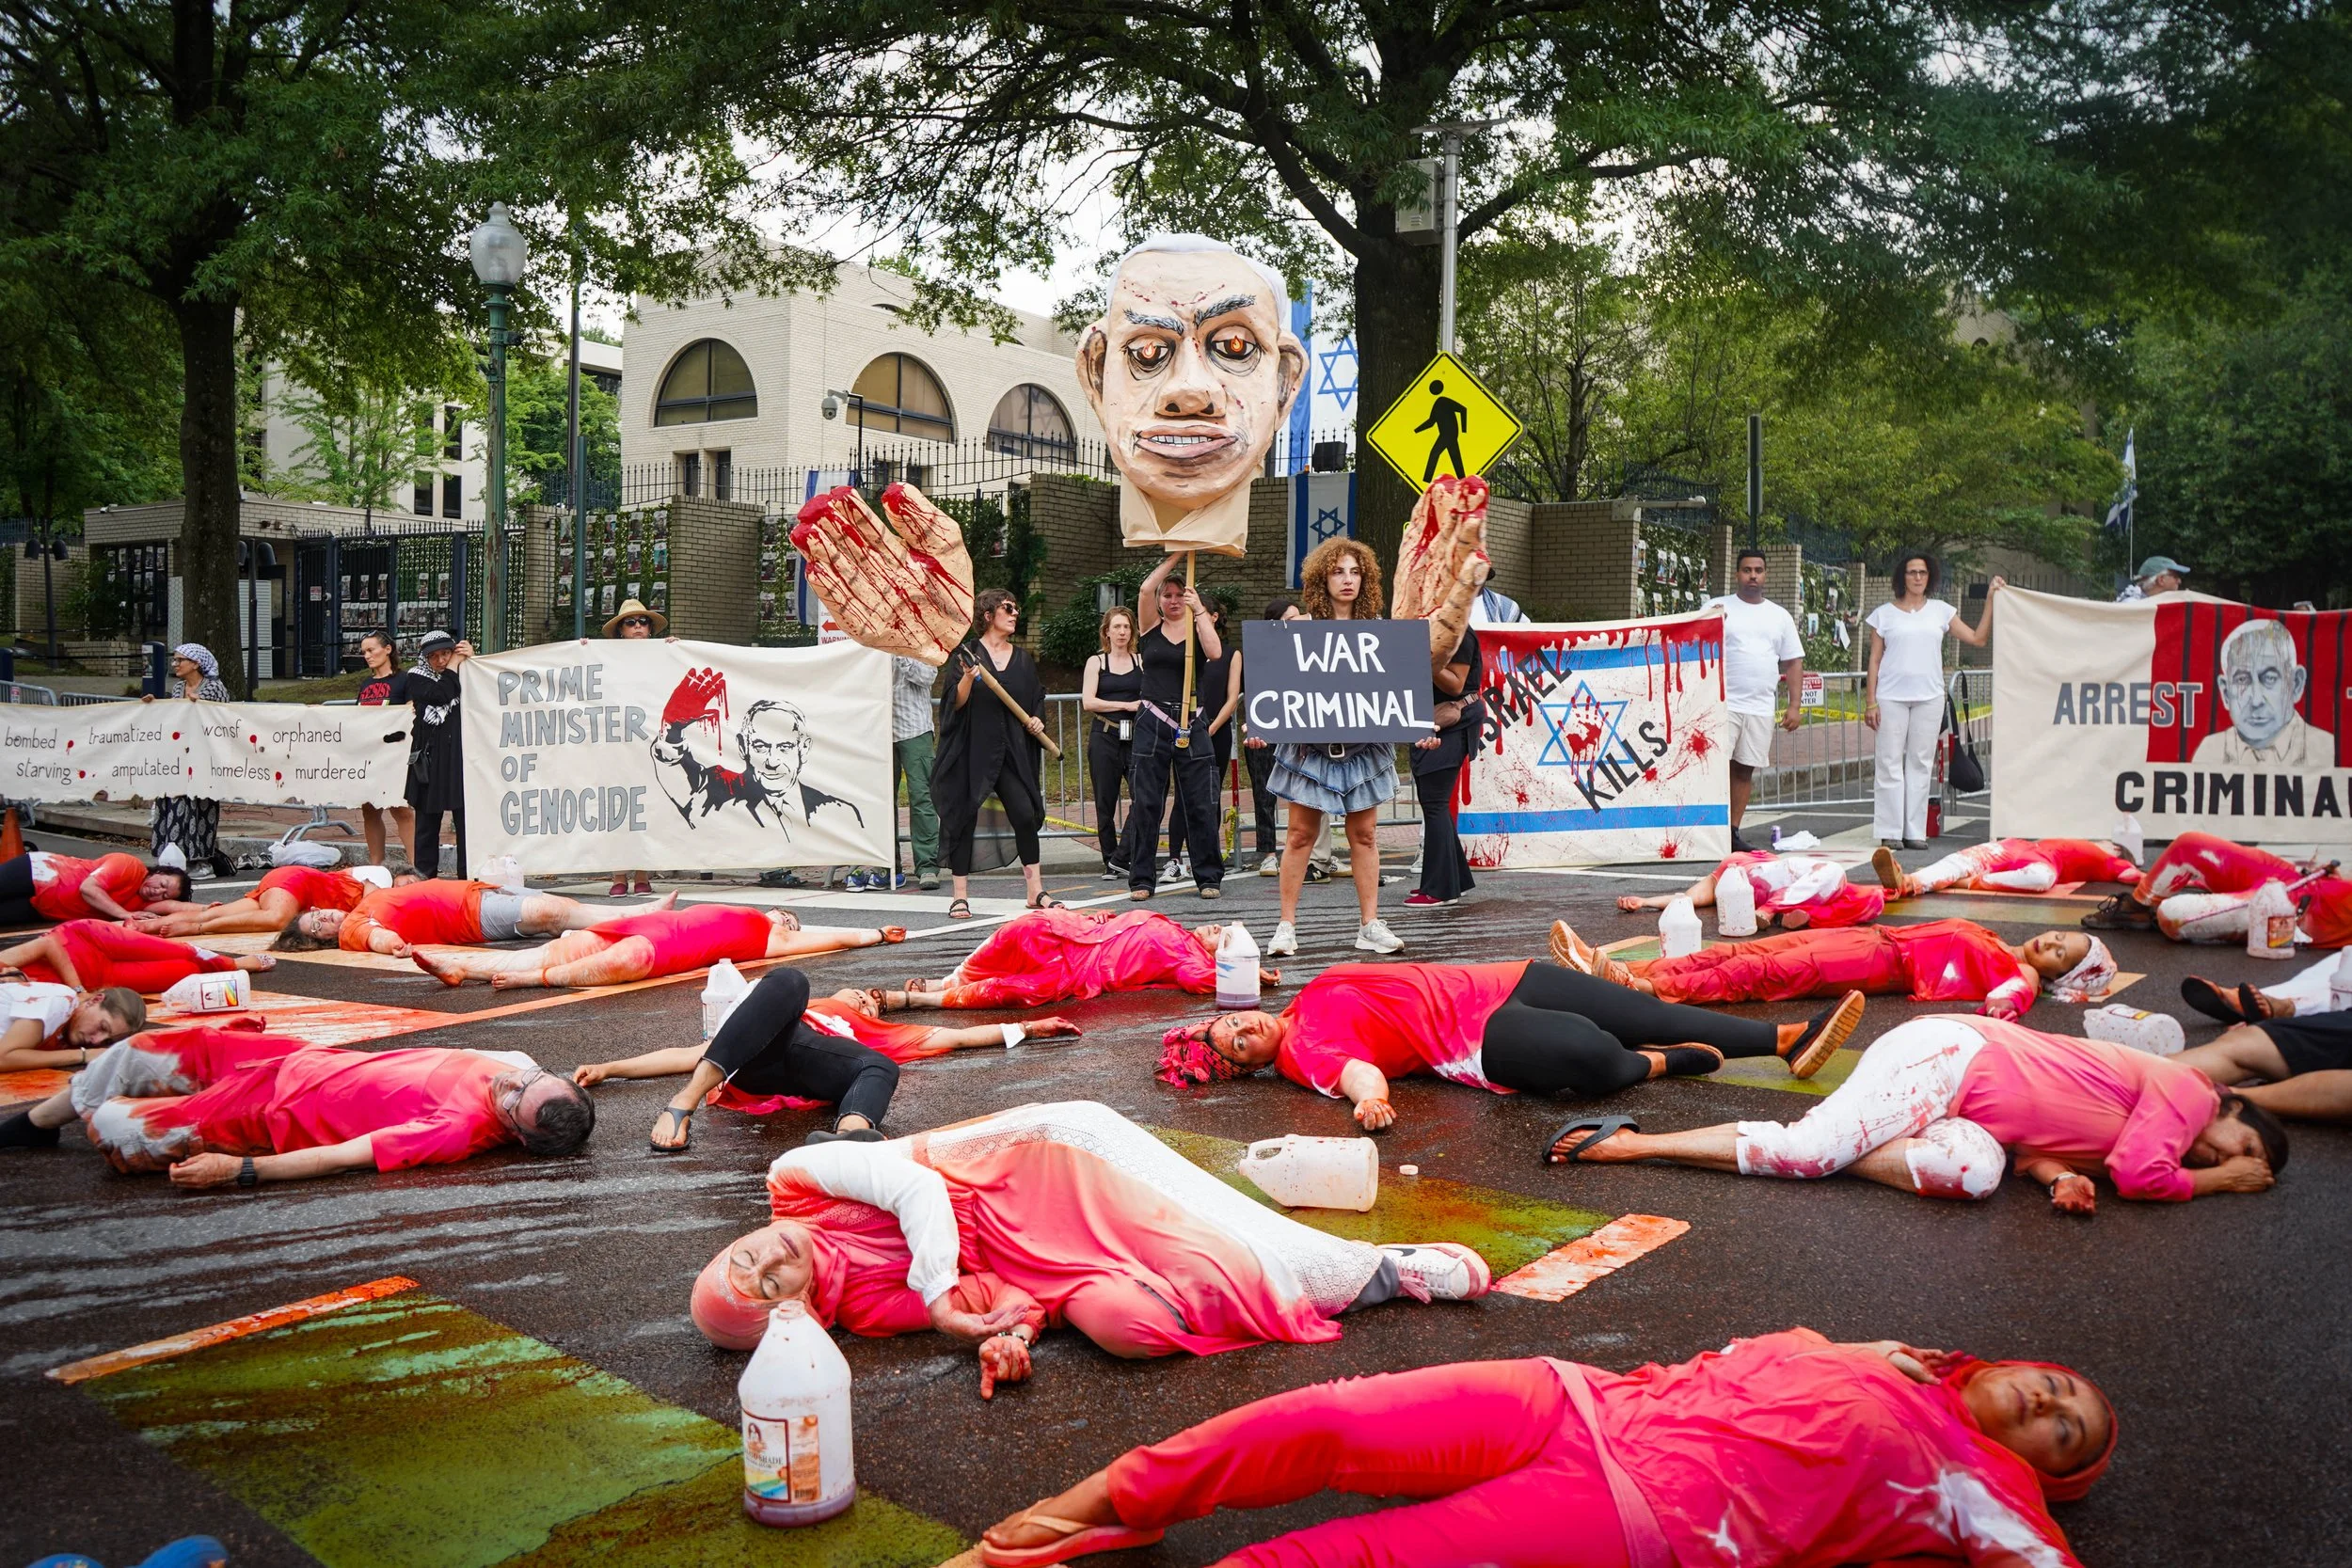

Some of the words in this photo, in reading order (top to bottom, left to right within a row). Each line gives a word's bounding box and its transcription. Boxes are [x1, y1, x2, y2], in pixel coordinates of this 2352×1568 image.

[1293, 632, 1386, 673] WAR
[497, 664, 603, 705] PRIME
[2053, 682, 2202, 728] ARREST
[499, 705, 649, 748] MINISTER
[1249, 689, 1435, 729] CRIMINAL
[5, 725, 57, 749] bombed
[88, 722, 163, 744] traumatized
[202, 719, 242, 738] wcnsf
[272, 721, 342, 752] orphaned
[16, 757, 72, 785] starving
[112, 756, 180, 785] amputated
[210, 755, 271, 781] homeless
[501, 753, 537, 783] OF
[1574, 721, 1668, 814] KILLS
[501, 785, 646, 836] GENOCIDE
[2115, 770, 2352, 817] CRIMINA
